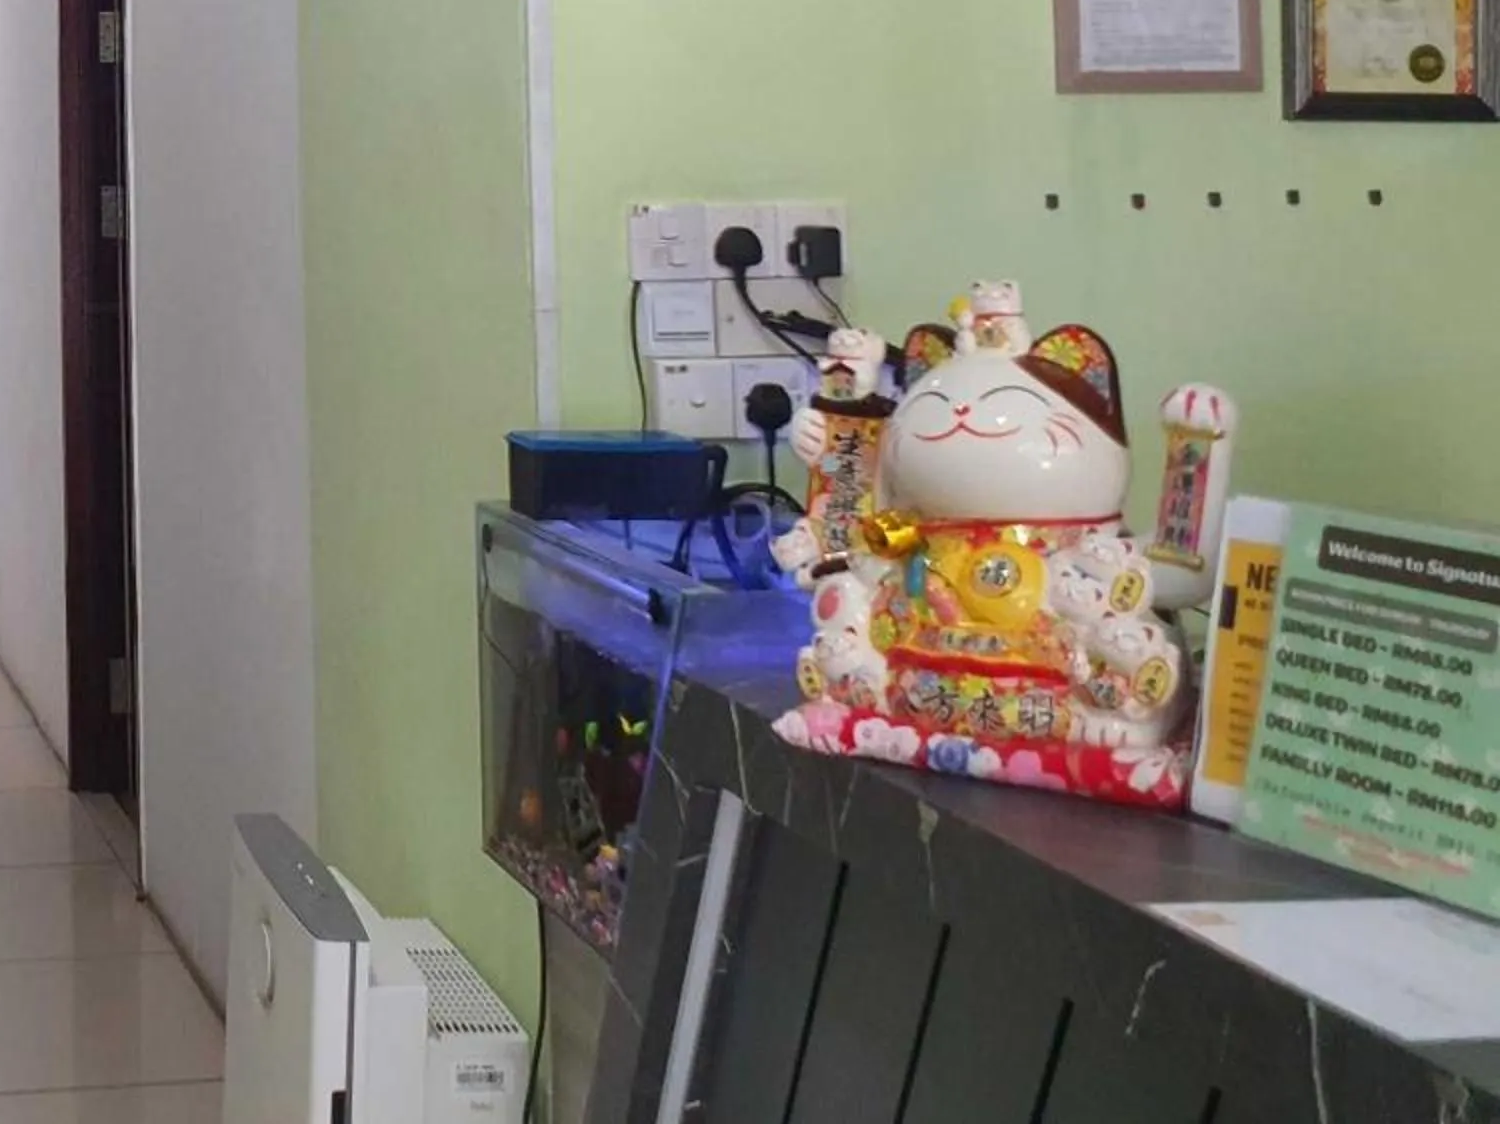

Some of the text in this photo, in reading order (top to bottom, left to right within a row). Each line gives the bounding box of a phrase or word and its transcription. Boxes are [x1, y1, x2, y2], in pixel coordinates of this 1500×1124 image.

[1328, 540, 1403, 570] Welcome
[1405, 557, 1425, 573] to
[1341, 631, 1377, 654] BED
[1275, 648, 1333, 676] QUEEN
[1333, 662, 1370, 686] BED
[1313, 691, 1349, 715] BED
[1264, 712, 1329, 745] DELUXE
[1331, 731, 1379, 758] TWIN
[1379, 745, 1418, 769] BED
[1334, 766, 1393, 798] ROOM
